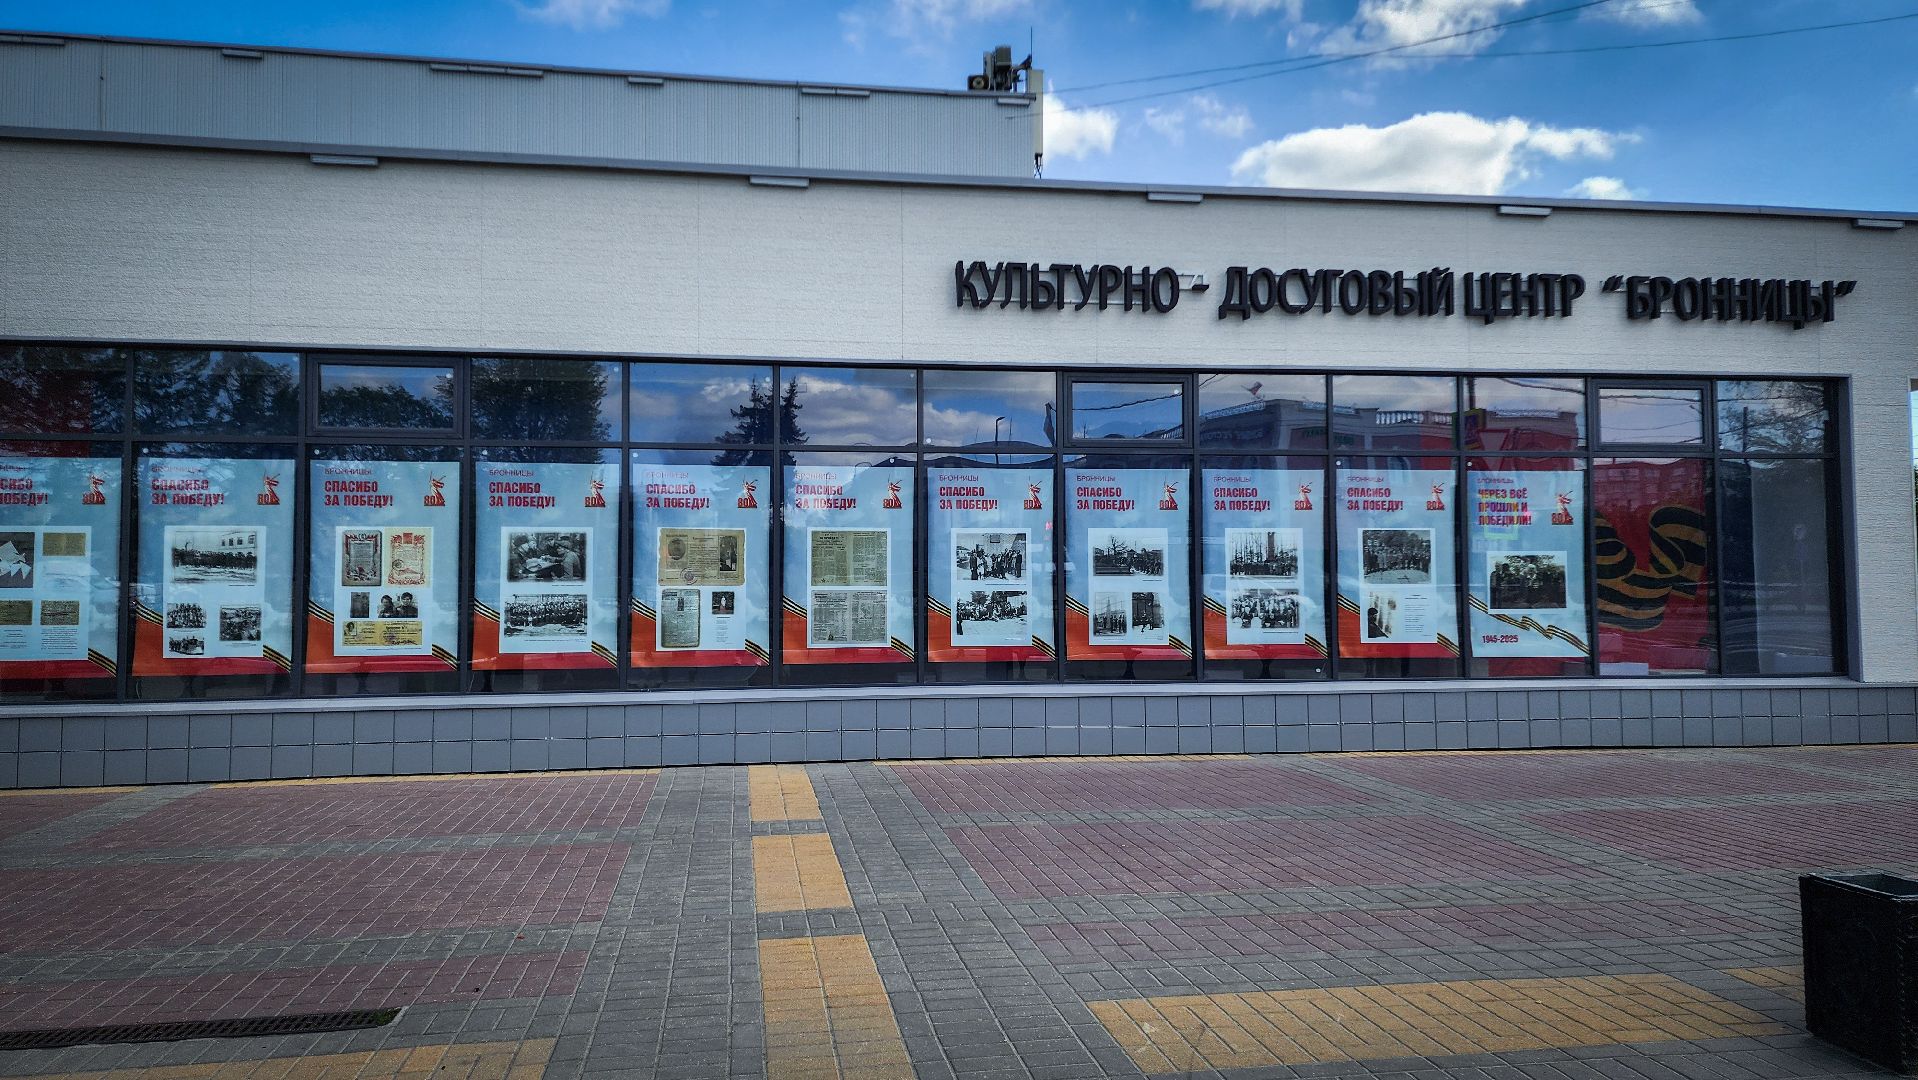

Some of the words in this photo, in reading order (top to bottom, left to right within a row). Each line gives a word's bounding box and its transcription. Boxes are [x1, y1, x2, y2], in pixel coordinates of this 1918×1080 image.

[955, 260, 1180, 314] КУЛЬТУРНО
[1218, 266, 1455, 321] ДОСУГОВЫЙ
[1463, 271, 1587, 325] ЦЕНТР
[152, 479, 209, 490] СПАСИБО
[324, 480, 378, 492] СПАСИБО
[489, 482, 541, 494] СПАСИБО
[646, 484, 696, 494] СПАСИБО
[796, 484, 843, 496] СПАСИБО
[940, 486, 985, 497] СПАСИБО
[1076, 486, 1122, 498] СПАСИБО
[1214, 488, 1258, 498] СПАСИБО
[1347, 488, 1391, 498] СПАСИБО
[1478, 489, 1507, 499] ЧЕРЕЗ
[152, 493, 168, 504] ЗА
[172, 493, 225, 506] ПОБЕДУ!
[324, 494, 340, 506] ЗА
[344, 494, 394, 508] ПОБЕДУ!
[489, 496, 503, 507] ЗА
[507, 496, 555, 509] ПОБЕДУ!
[646, 497, 660, 508] ЗА
[664, 497, 710, 510] ПОБЕДУ!
[796, 498, 810, 508] ЗА
[813, 498, 856, 510] ПОБЕДУ!
[940, 500, 953, 510] ЗА
[956, 500, 998, 512] ПОБЕДУ!
[1076, 500, 1090, 510] ЗА
[1092, 500, 1135, 512] ПОБЕДУ!
[1214, 500, 1227, 511] ЗА
[1228, 500, 1271, 512] ПОБЕДУ!
[1347, 500, 1360, 511] ЗА
[1362, 500, 1404, 512] ПОБЕДУ!
[1478, 502, 1519, 512] ПРОШЛИ
[1521, 502, 1528, 512] И
[1478, 515, 1532, 528] ПОБЕДИЛИ!
[1482, 634, 1519, 644] 1945-2025
